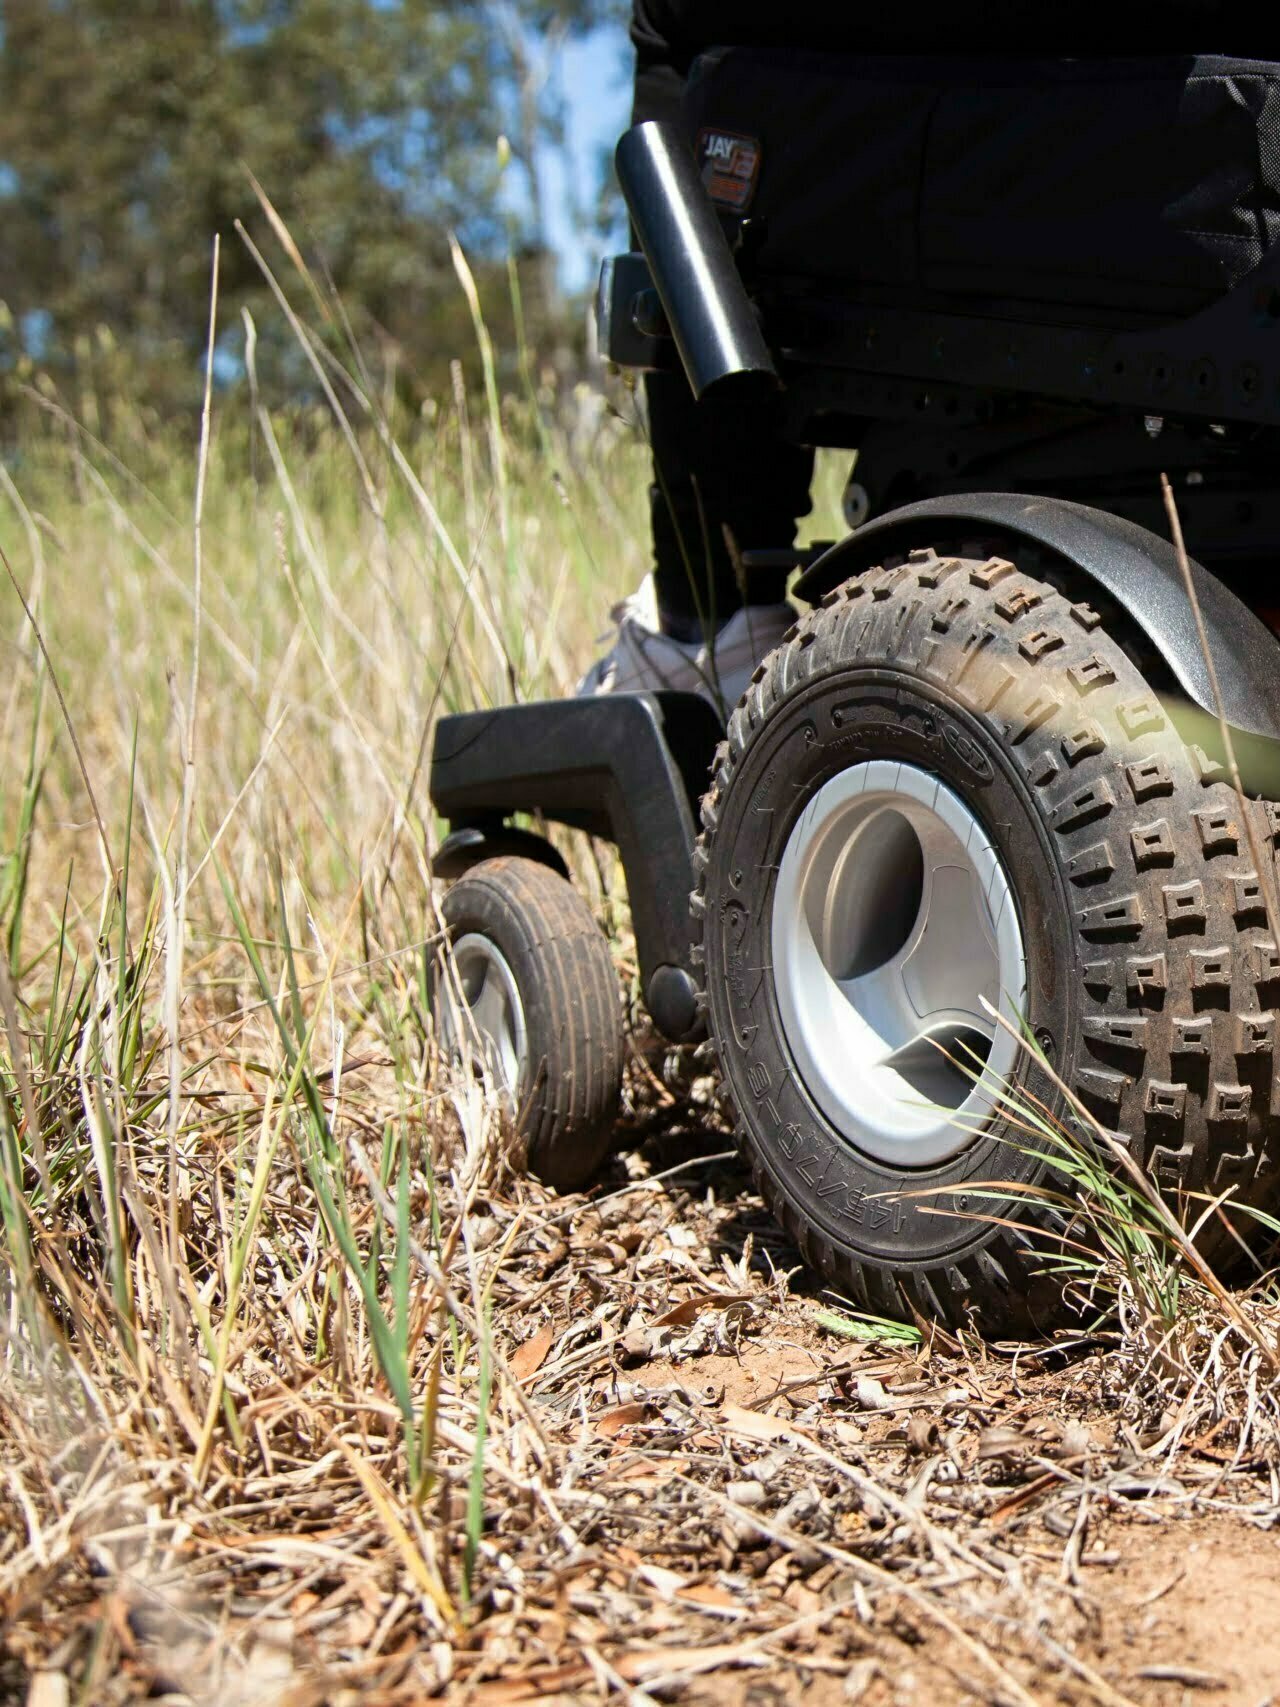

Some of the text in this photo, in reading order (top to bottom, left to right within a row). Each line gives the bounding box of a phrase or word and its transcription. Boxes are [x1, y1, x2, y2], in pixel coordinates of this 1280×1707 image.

[704, 134, 733, 160] JAY
[942, 723, 987, 772] CST
[747, 1061, 906, 1235] 145/70-6
